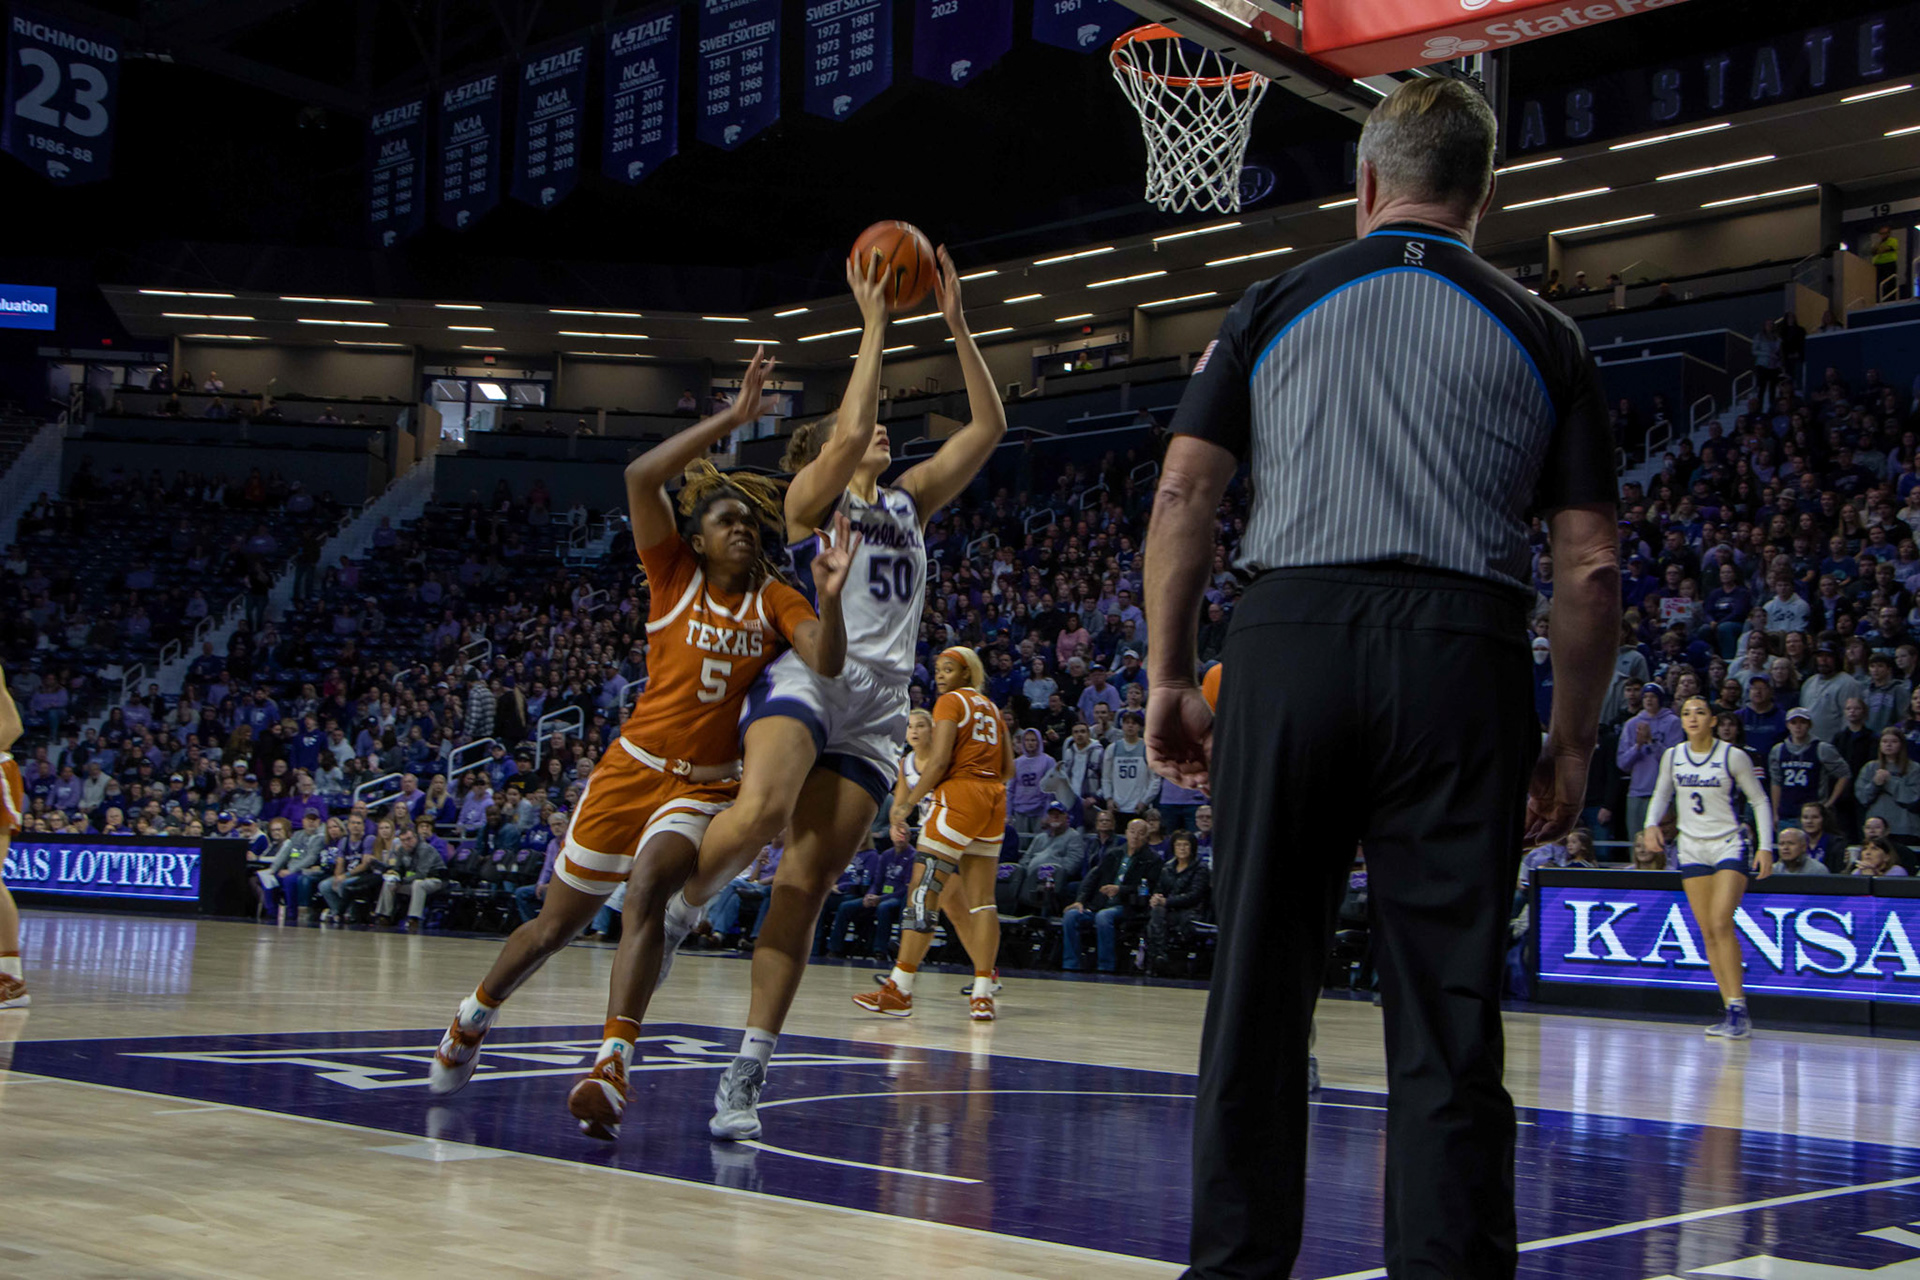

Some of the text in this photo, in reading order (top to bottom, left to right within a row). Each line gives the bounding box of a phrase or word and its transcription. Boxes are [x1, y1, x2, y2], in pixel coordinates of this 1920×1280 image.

[805, 0, 841, 22] SWEET
[930, 1, 959, 20] 2023
[1054, 0, 1082, 16] 1961
[610, 14, 674, 50] K-STATE
[728, 18, 748, 31] NCAA
[817, 12, 875, 39] 1972 1981
[1485, 0, 1616, 44] State
[13, 16, 119, 63] RICHMOND
[699, 19, 776, 53] SWEET SIXTEEN
[816, 28, 875, 56] 1973 1982
[525, 46, 584, 80] K-STATE
[622, 57, 656, 81] NCAA
[709, 45, 763, 71] 1951 1961
[815, 43, 875, 71] 1975 1988
[708, 61, 764, 86] 1956 1964
[814, 59, 874, 87] 1977 2010
[1649, 17, 1890, 123] STATE
[14, 47, 110, 138] 23
[443, 75, 497, 107] K-STATE
[537, 87, 567, 109] NCAA
[614, 85, 664, 110] 2011 2017
[707, 76, 763, 101] 1958 1968
[371, 100, 423, 131] K-STATE
[613, 100, 664, 124] 2012 2018
[706, 91, 762, 116] 1959 1970
[453, 114, 482, 135] NCAA
[612, 114, 663, 139] 2013 2019
[27, 133, 94, 164] 1986-88
[381, 138, 408, 158] NCAA
[611, 129, 662, 153] 2014 2023
[553, 156, 574, 171] 2010
[1871, 204, 1890, 218] 19
[1515, 264, 1532, 279] 19
[0, 299, 49, 314] luation
[868, 555, 914, 603] 50
[685, 618, 763, 658] TEXAS
[697, 656, 732, 704] 5
[972, 711, 998, 746] 23
[1119, 765, 1137, 779] 50
[1675, 772, 1722, 788] Wildcats
[1784, 769, 1809, 787] 24
[1690, 791, 1705, 815] 3
[57, 850, 201, 888] LOTTERY
